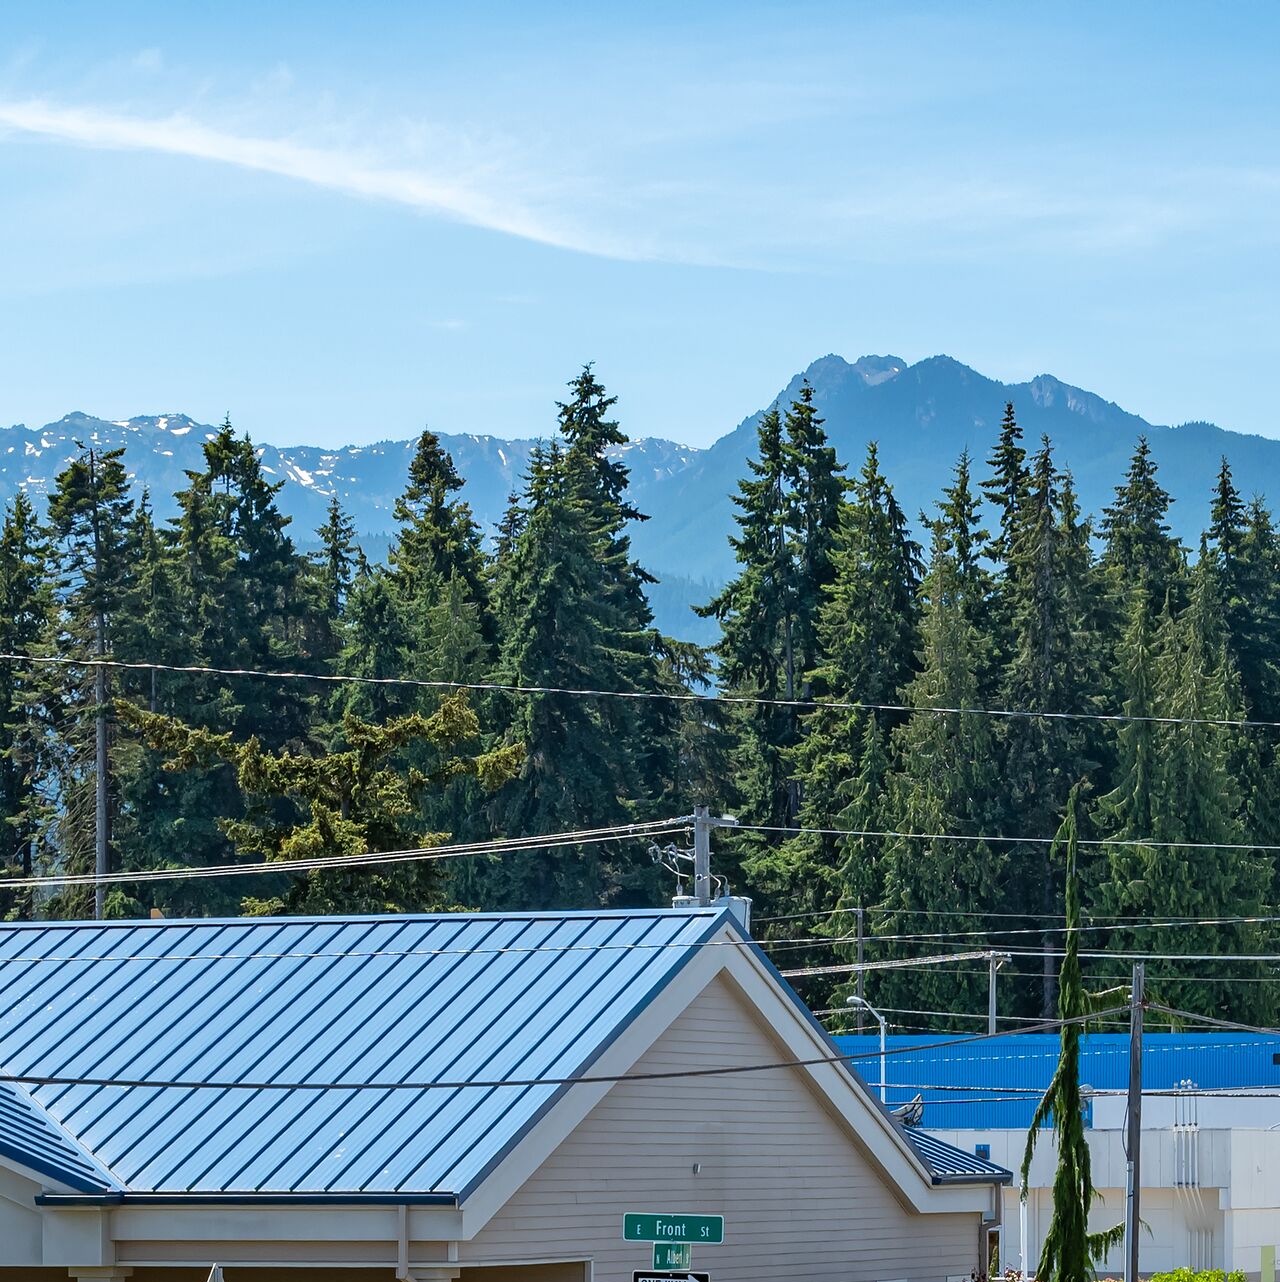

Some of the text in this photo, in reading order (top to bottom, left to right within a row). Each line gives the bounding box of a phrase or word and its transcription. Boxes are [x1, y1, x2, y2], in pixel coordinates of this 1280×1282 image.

[636, 1220, 710, 1238] E Front St
